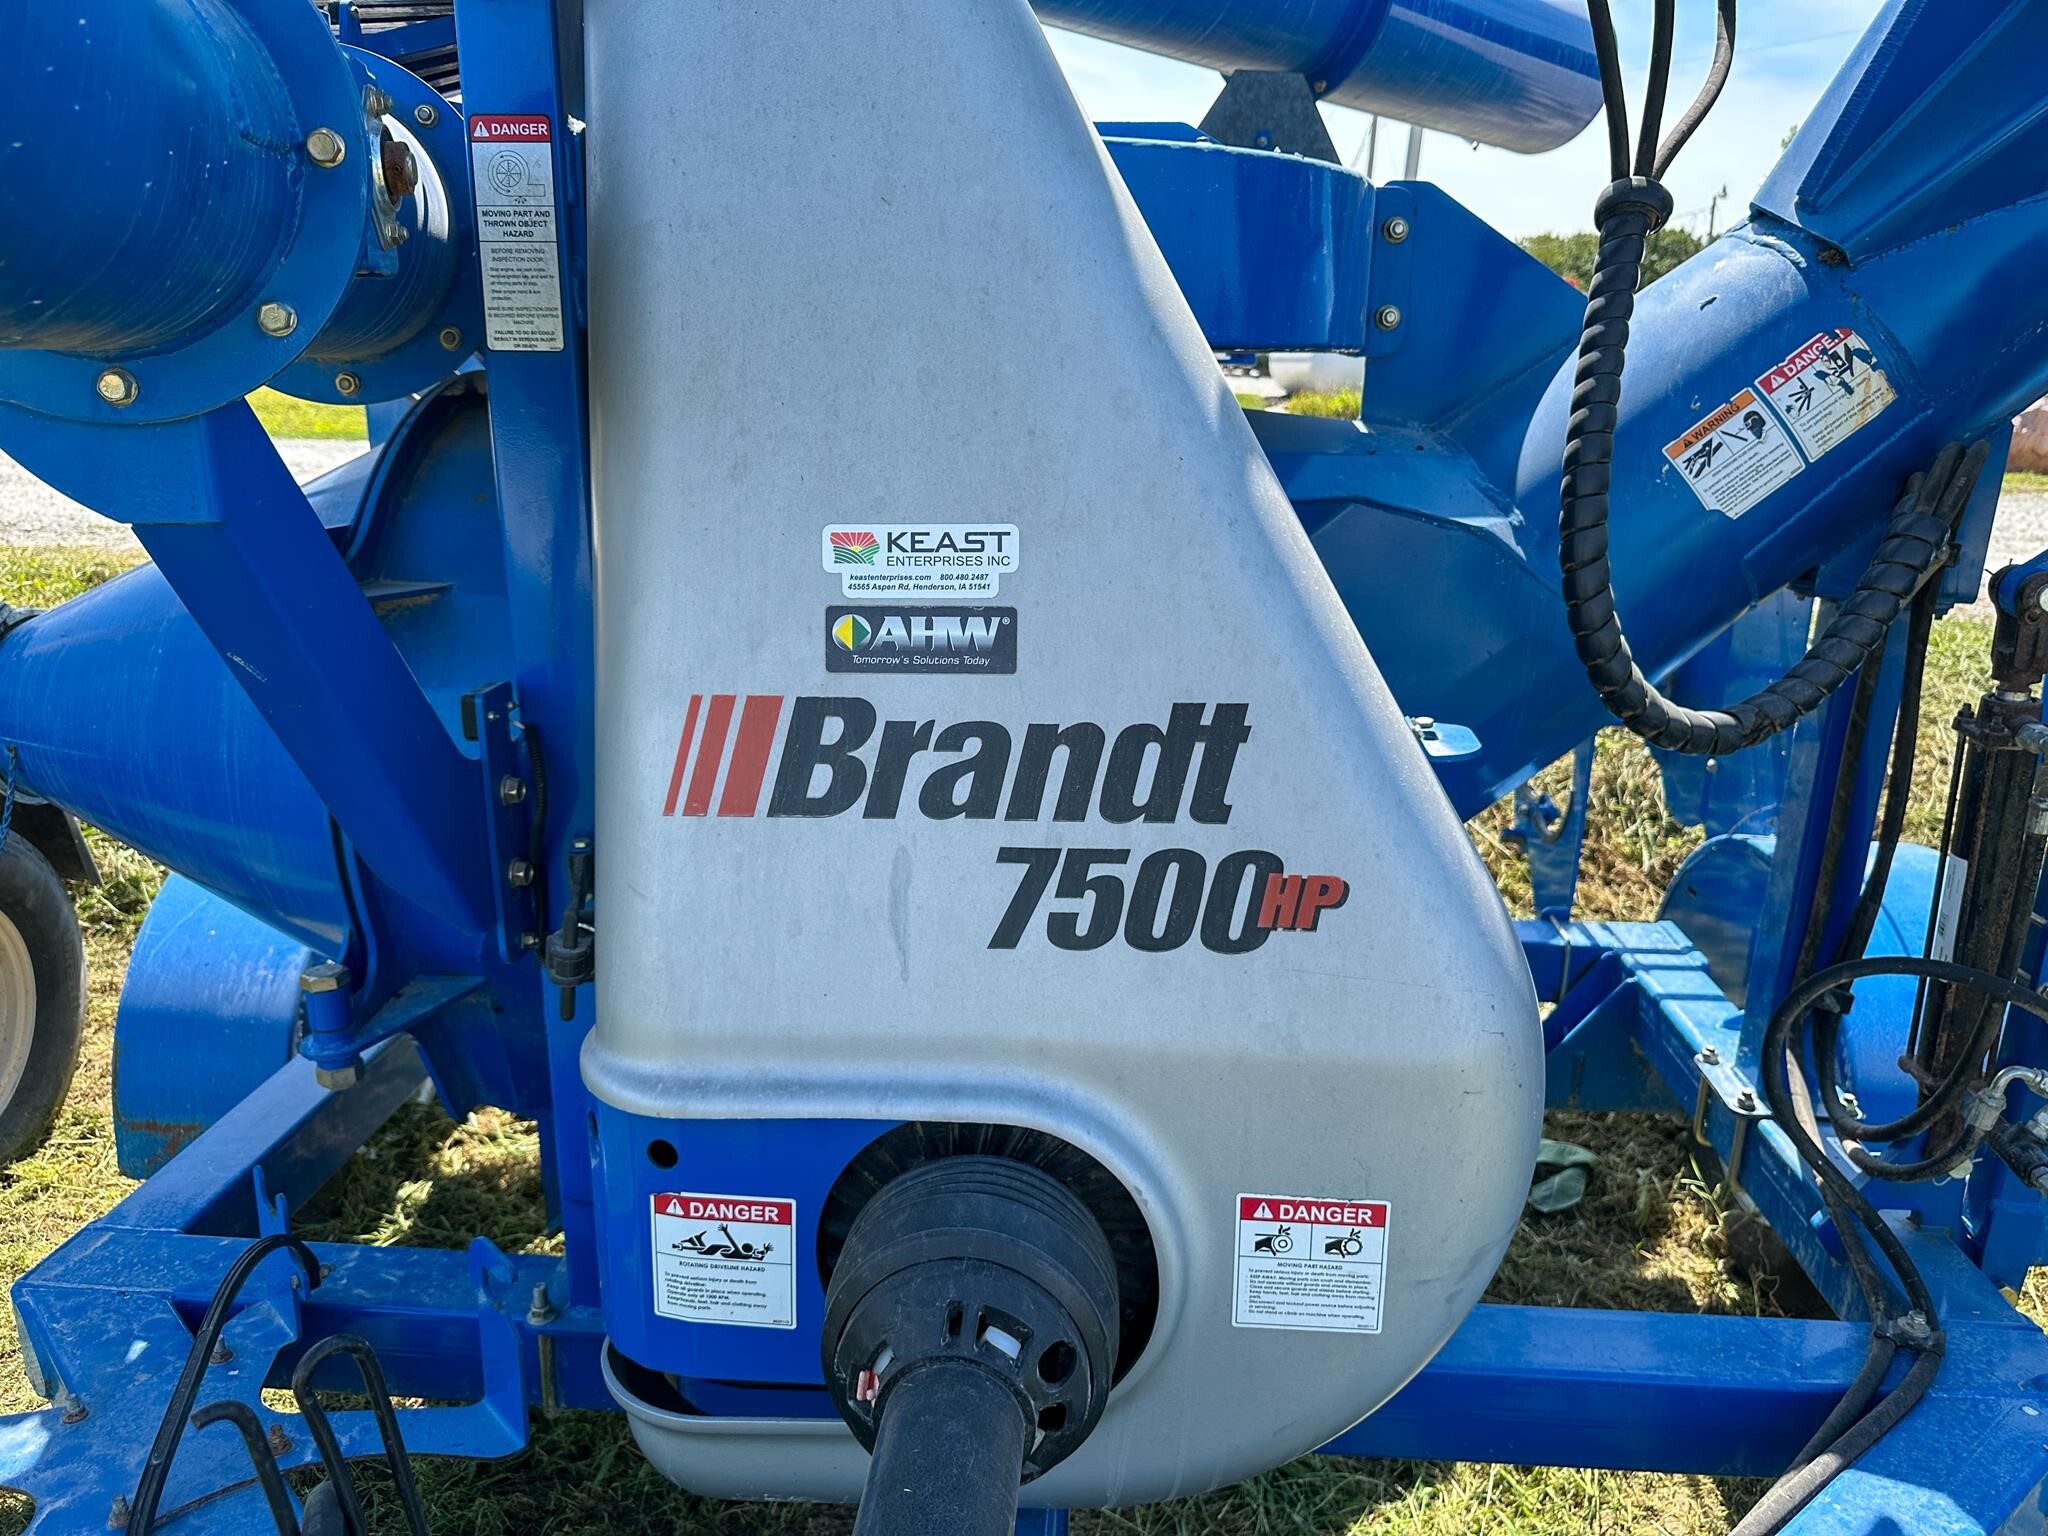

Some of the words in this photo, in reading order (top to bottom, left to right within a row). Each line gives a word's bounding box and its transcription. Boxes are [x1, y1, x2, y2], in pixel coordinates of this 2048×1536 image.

[491, 124, 548, 135] DANGER
[1691, 403, 1740, 440] WARNING
[887, 532, 1011, 552] KEAST
[887, 556, 983, 566] ENTERPRISES
[988, 556, 1010, 566] INC
[850, 574, 932, 582] keastenterprises.com
[872, 583, 896, 592] Aspen
[898, 584, 911, 592] Rd,
[912, 584, 956, 592] Henderson,
[852, 654, 910, 664] Tomorrow's
[912, 656, 960, 665] Solutions
[963, 656, 990, 666] Today
[766, 696, 1252, 825] Brandt
[689, 1202, 780, 1222] DANGER
[1279, 1204, 1373, 1224] DANGER
[680, 1260, 708, 1269] ROTATING
